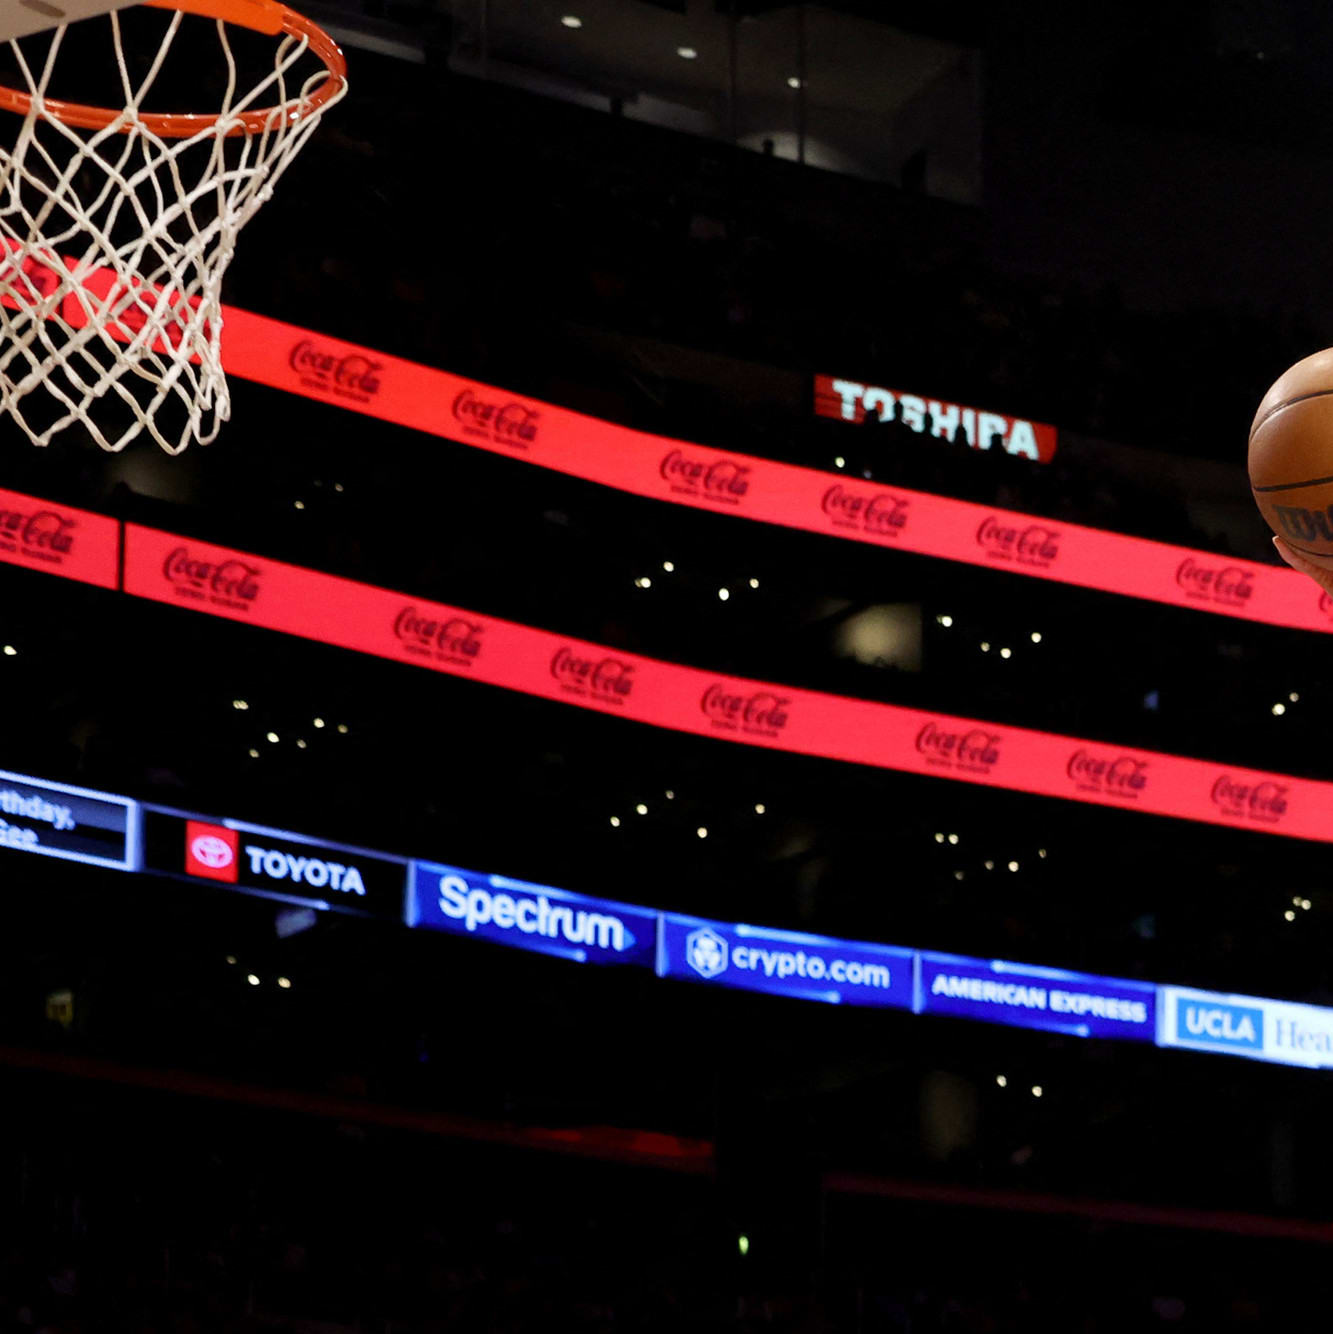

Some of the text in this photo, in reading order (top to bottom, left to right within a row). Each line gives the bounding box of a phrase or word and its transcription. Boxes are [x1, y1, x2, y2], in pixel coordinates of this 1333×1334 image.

[245, 844, 366, 895] TOYOTA
[438, 874, 626, 950] Spectrum
[731, 944, 891, 989] crypto.com
[932, 974, 1147, 1024] AMERICAN EXPRESS
[1185, 1006, 1255, 1042] UCLA
